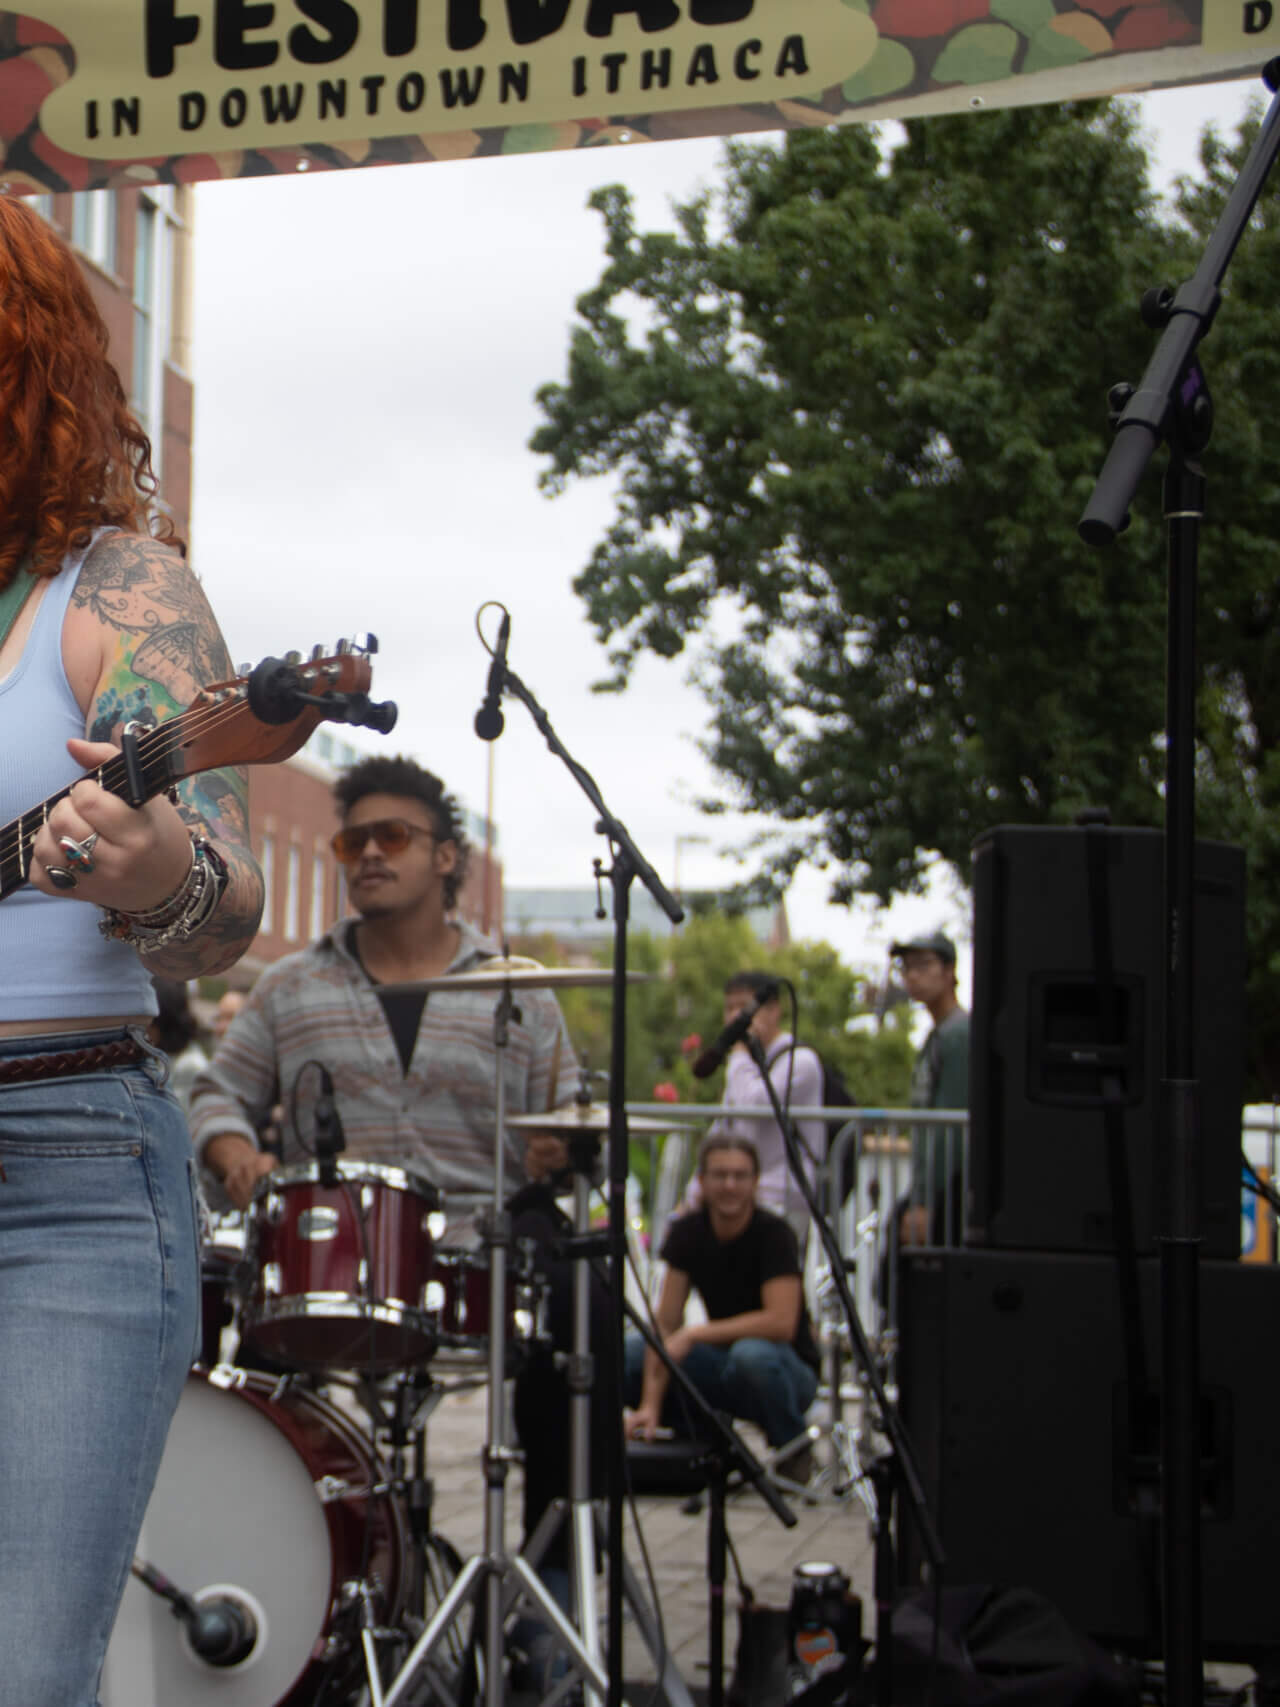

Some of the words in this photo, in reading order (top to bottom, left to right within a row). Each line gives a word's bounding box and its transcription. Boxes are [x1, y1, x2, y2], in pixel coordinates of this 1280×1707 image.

[145, 0, 756, 78] FEST
[86, 97, 140, 139] IN
[179, 62, 529, 131] DOWNTOWN
[572, 34, 809, 97] ITHACA
